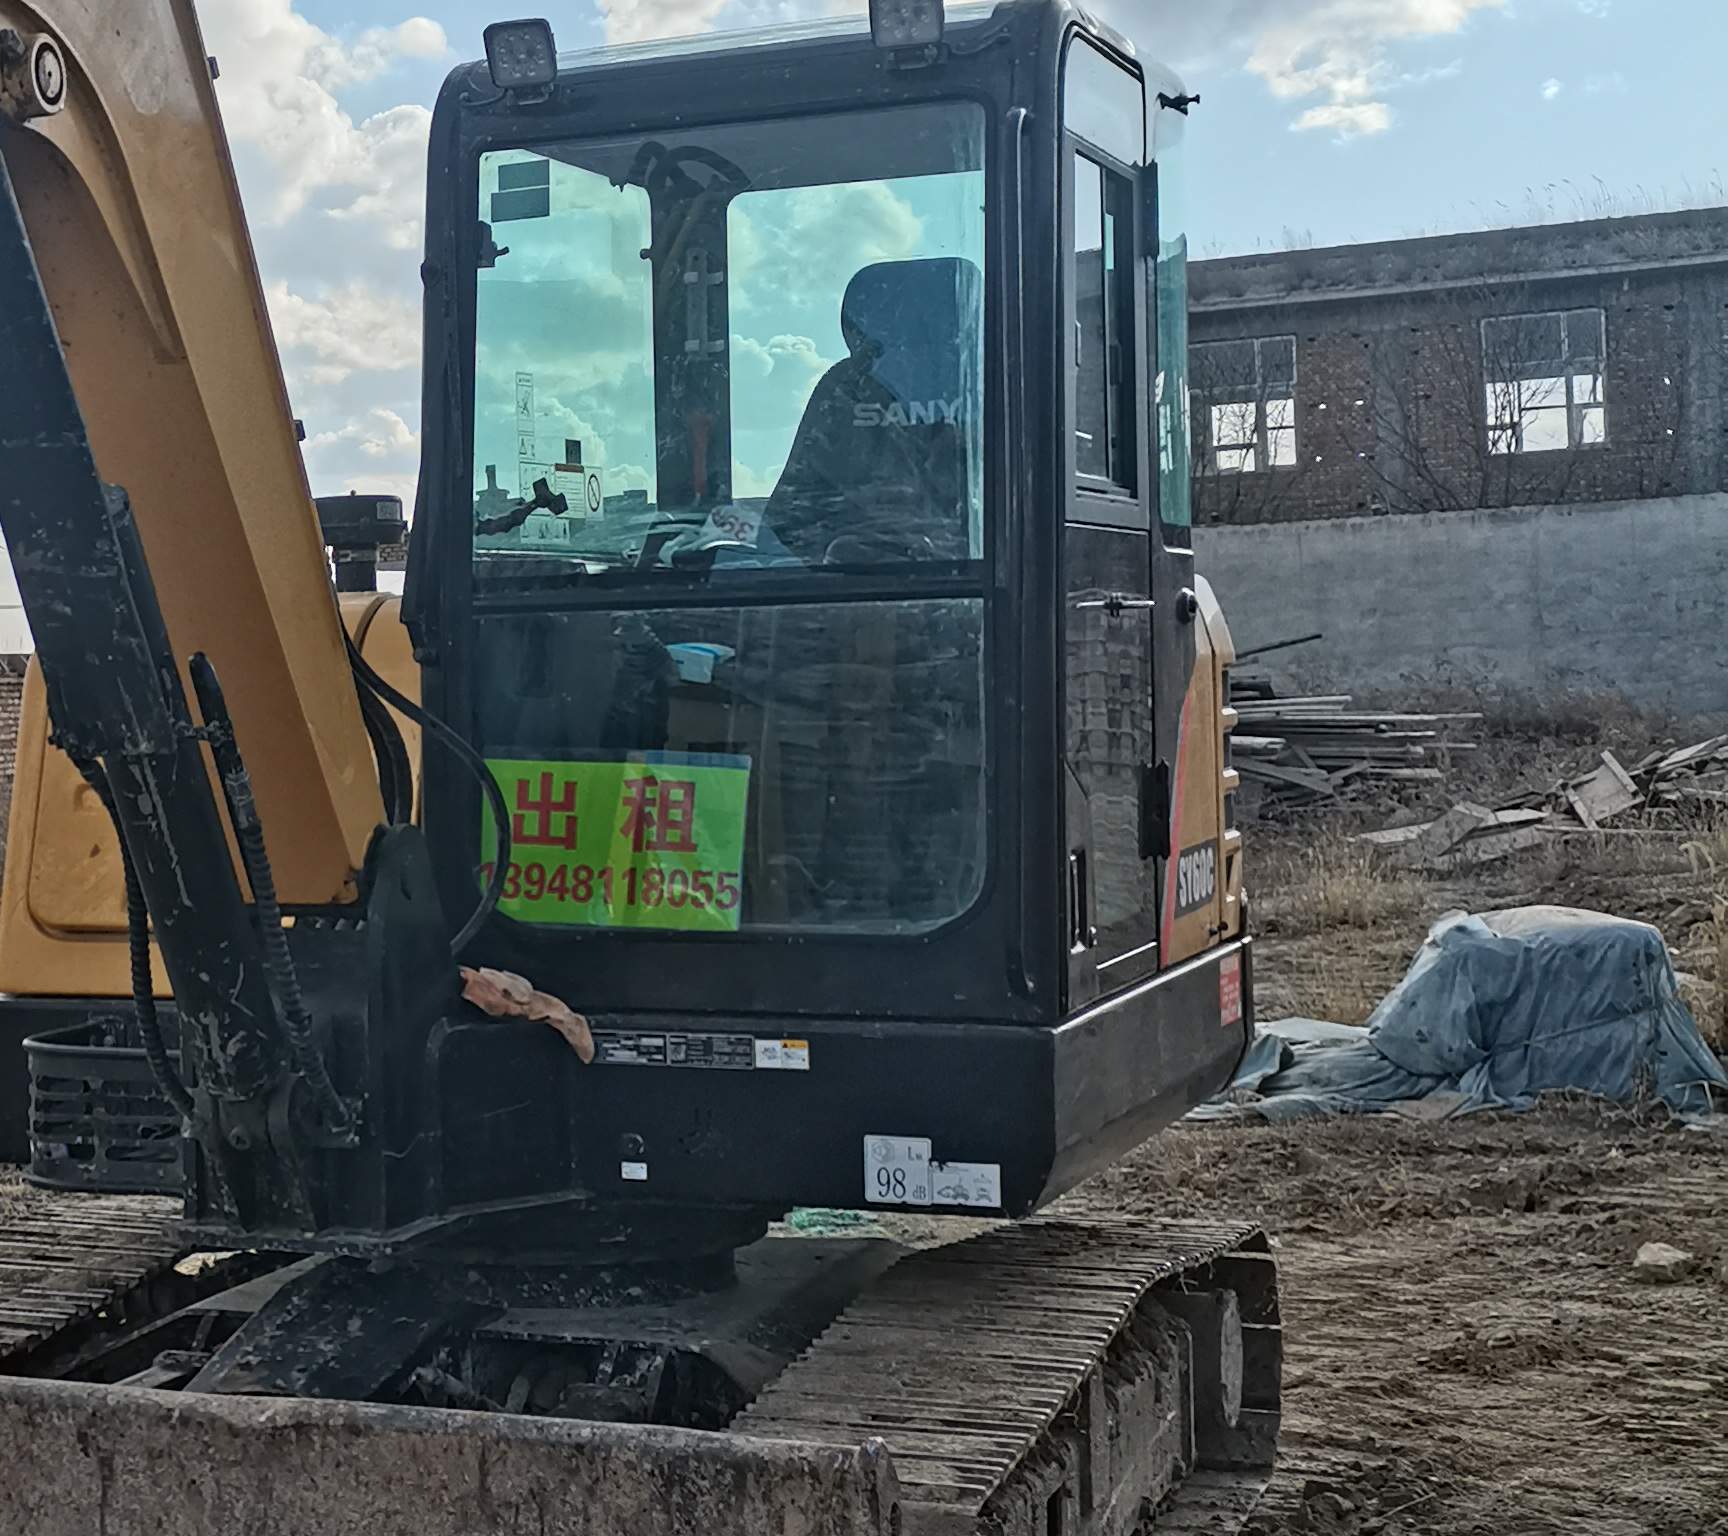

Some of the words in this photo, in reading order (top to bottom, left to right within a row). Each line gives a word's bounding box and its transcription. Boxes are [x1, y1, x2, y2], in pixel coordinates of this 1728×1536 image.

[853, 398, 963, 426] SANY
[512, 772, 697, 852] 出租
[1179, 847, 1214, 908] SY60C
[877, 1167, 906, 1199] 98
[912, 1184, 927, 1200] dB
